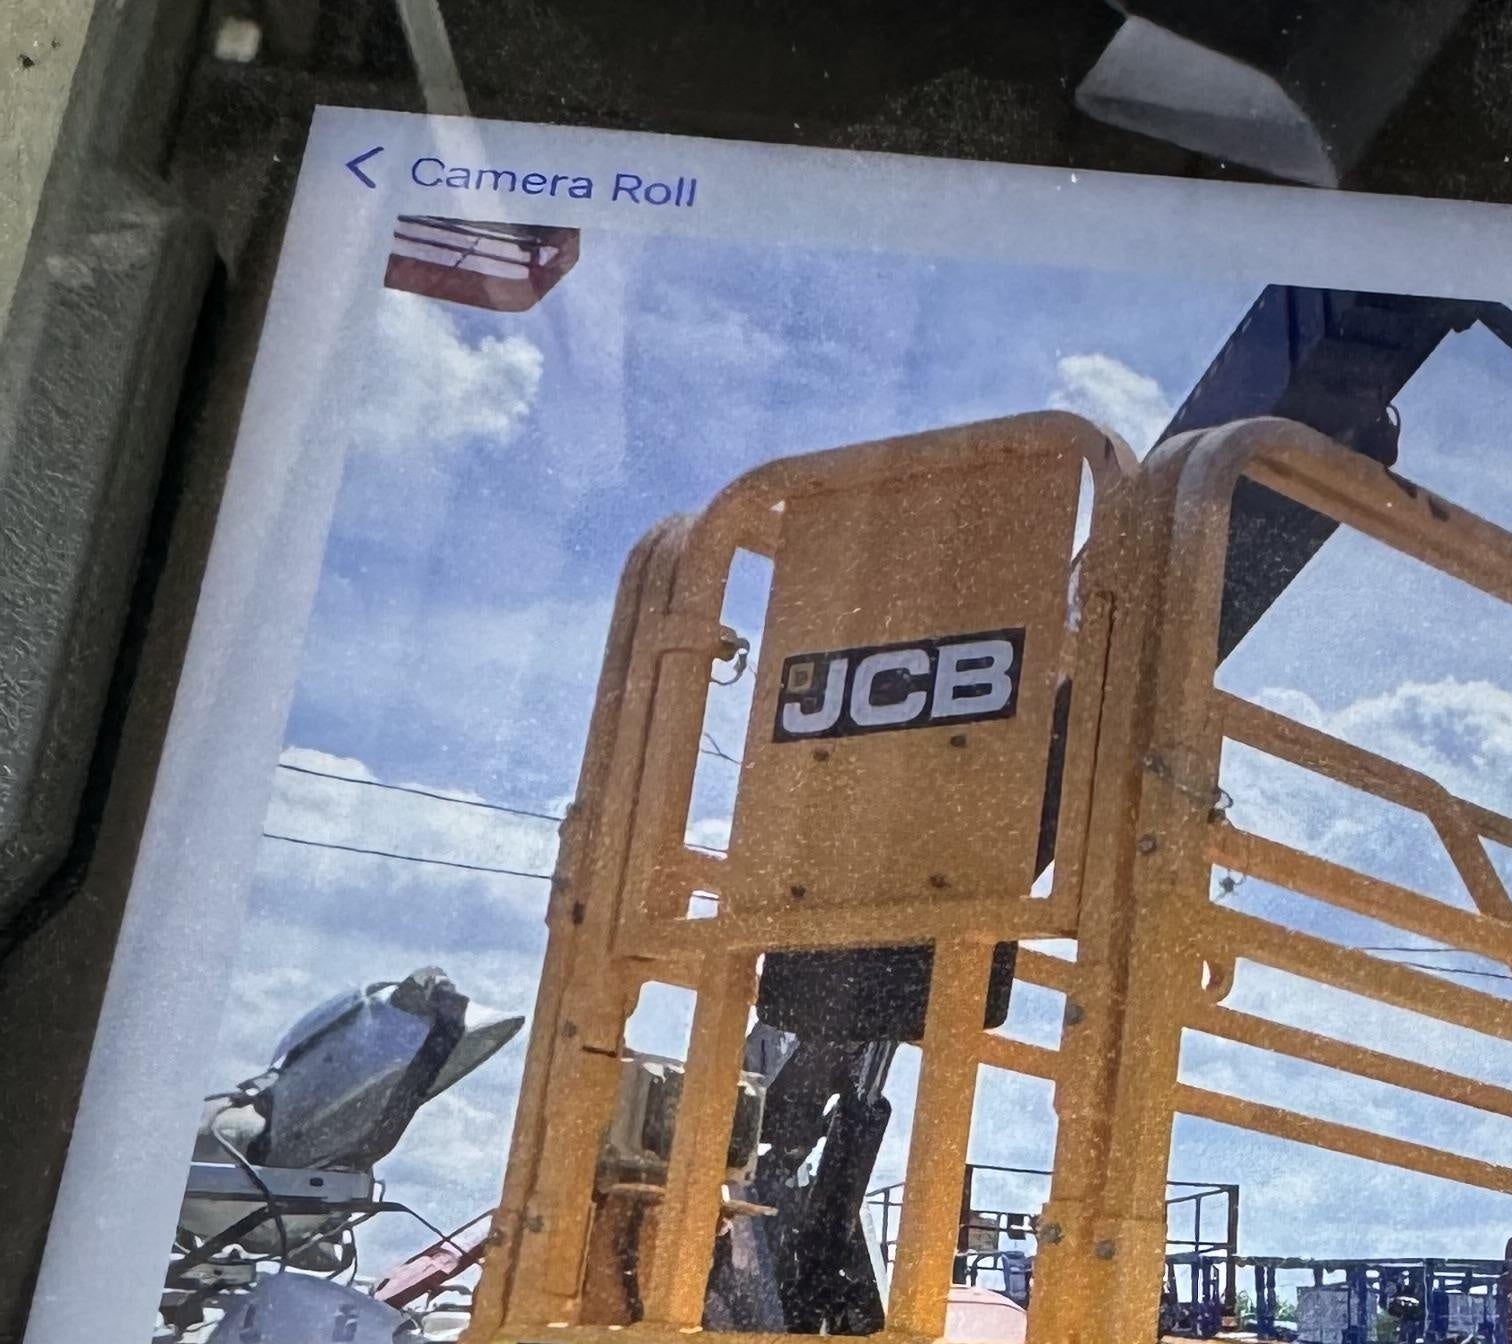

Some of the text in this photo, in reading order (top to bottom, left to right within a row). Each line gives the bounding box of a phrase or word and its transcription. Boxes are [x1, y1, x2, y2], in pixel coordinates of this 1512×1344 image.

[411, 157, 698, 207] Camera Roll
[781, 639, 1014, 734] JCB
